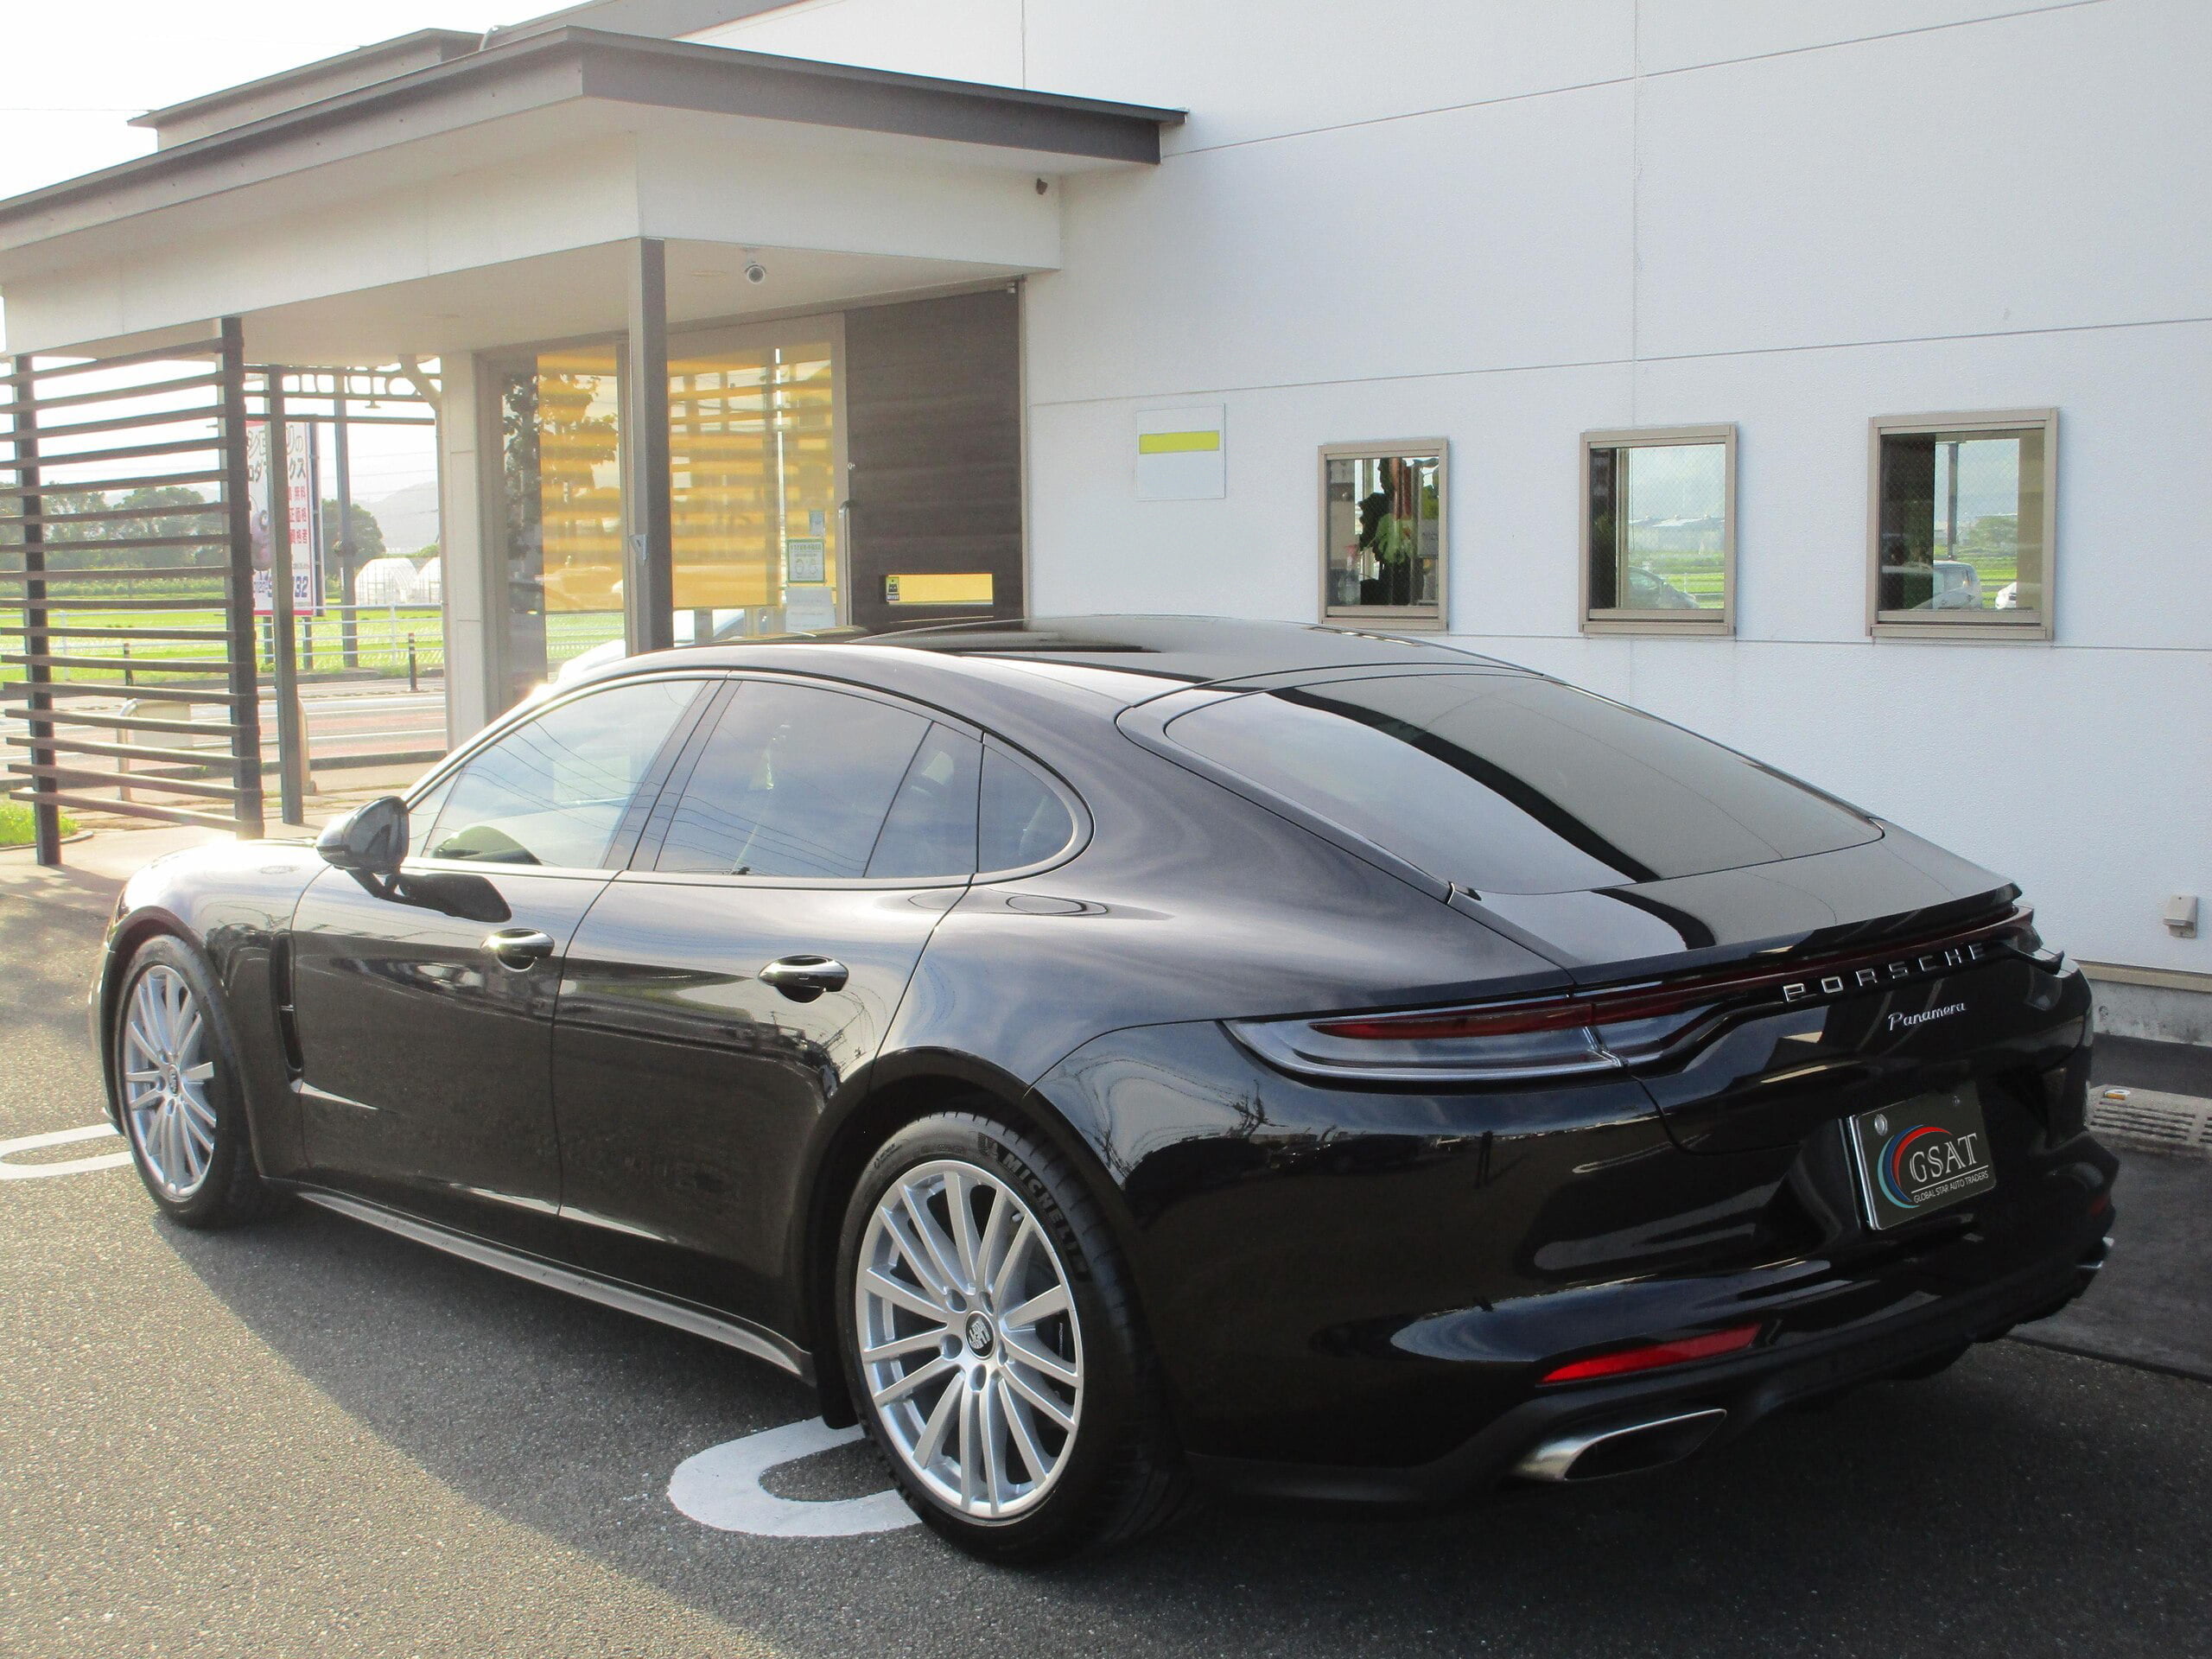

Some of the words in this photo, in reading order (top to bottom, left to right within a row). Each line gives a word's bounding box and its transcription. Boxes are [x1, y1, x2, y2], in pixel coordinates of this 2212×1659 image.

[1783, 943, 1986, 1002] PORSCHE
[1887, 1001, 1966, 1032] Panamera
[1909, 1132, 1978, 1184] GSAT
[1913, 1190, 1936, 1204] GLOBAL
[1936, 1184, 1949, 1196] STAR
[1949, 1179, 1965, 1190] AUTO
[1965, 1170, 1989, 1185] TRADERS
